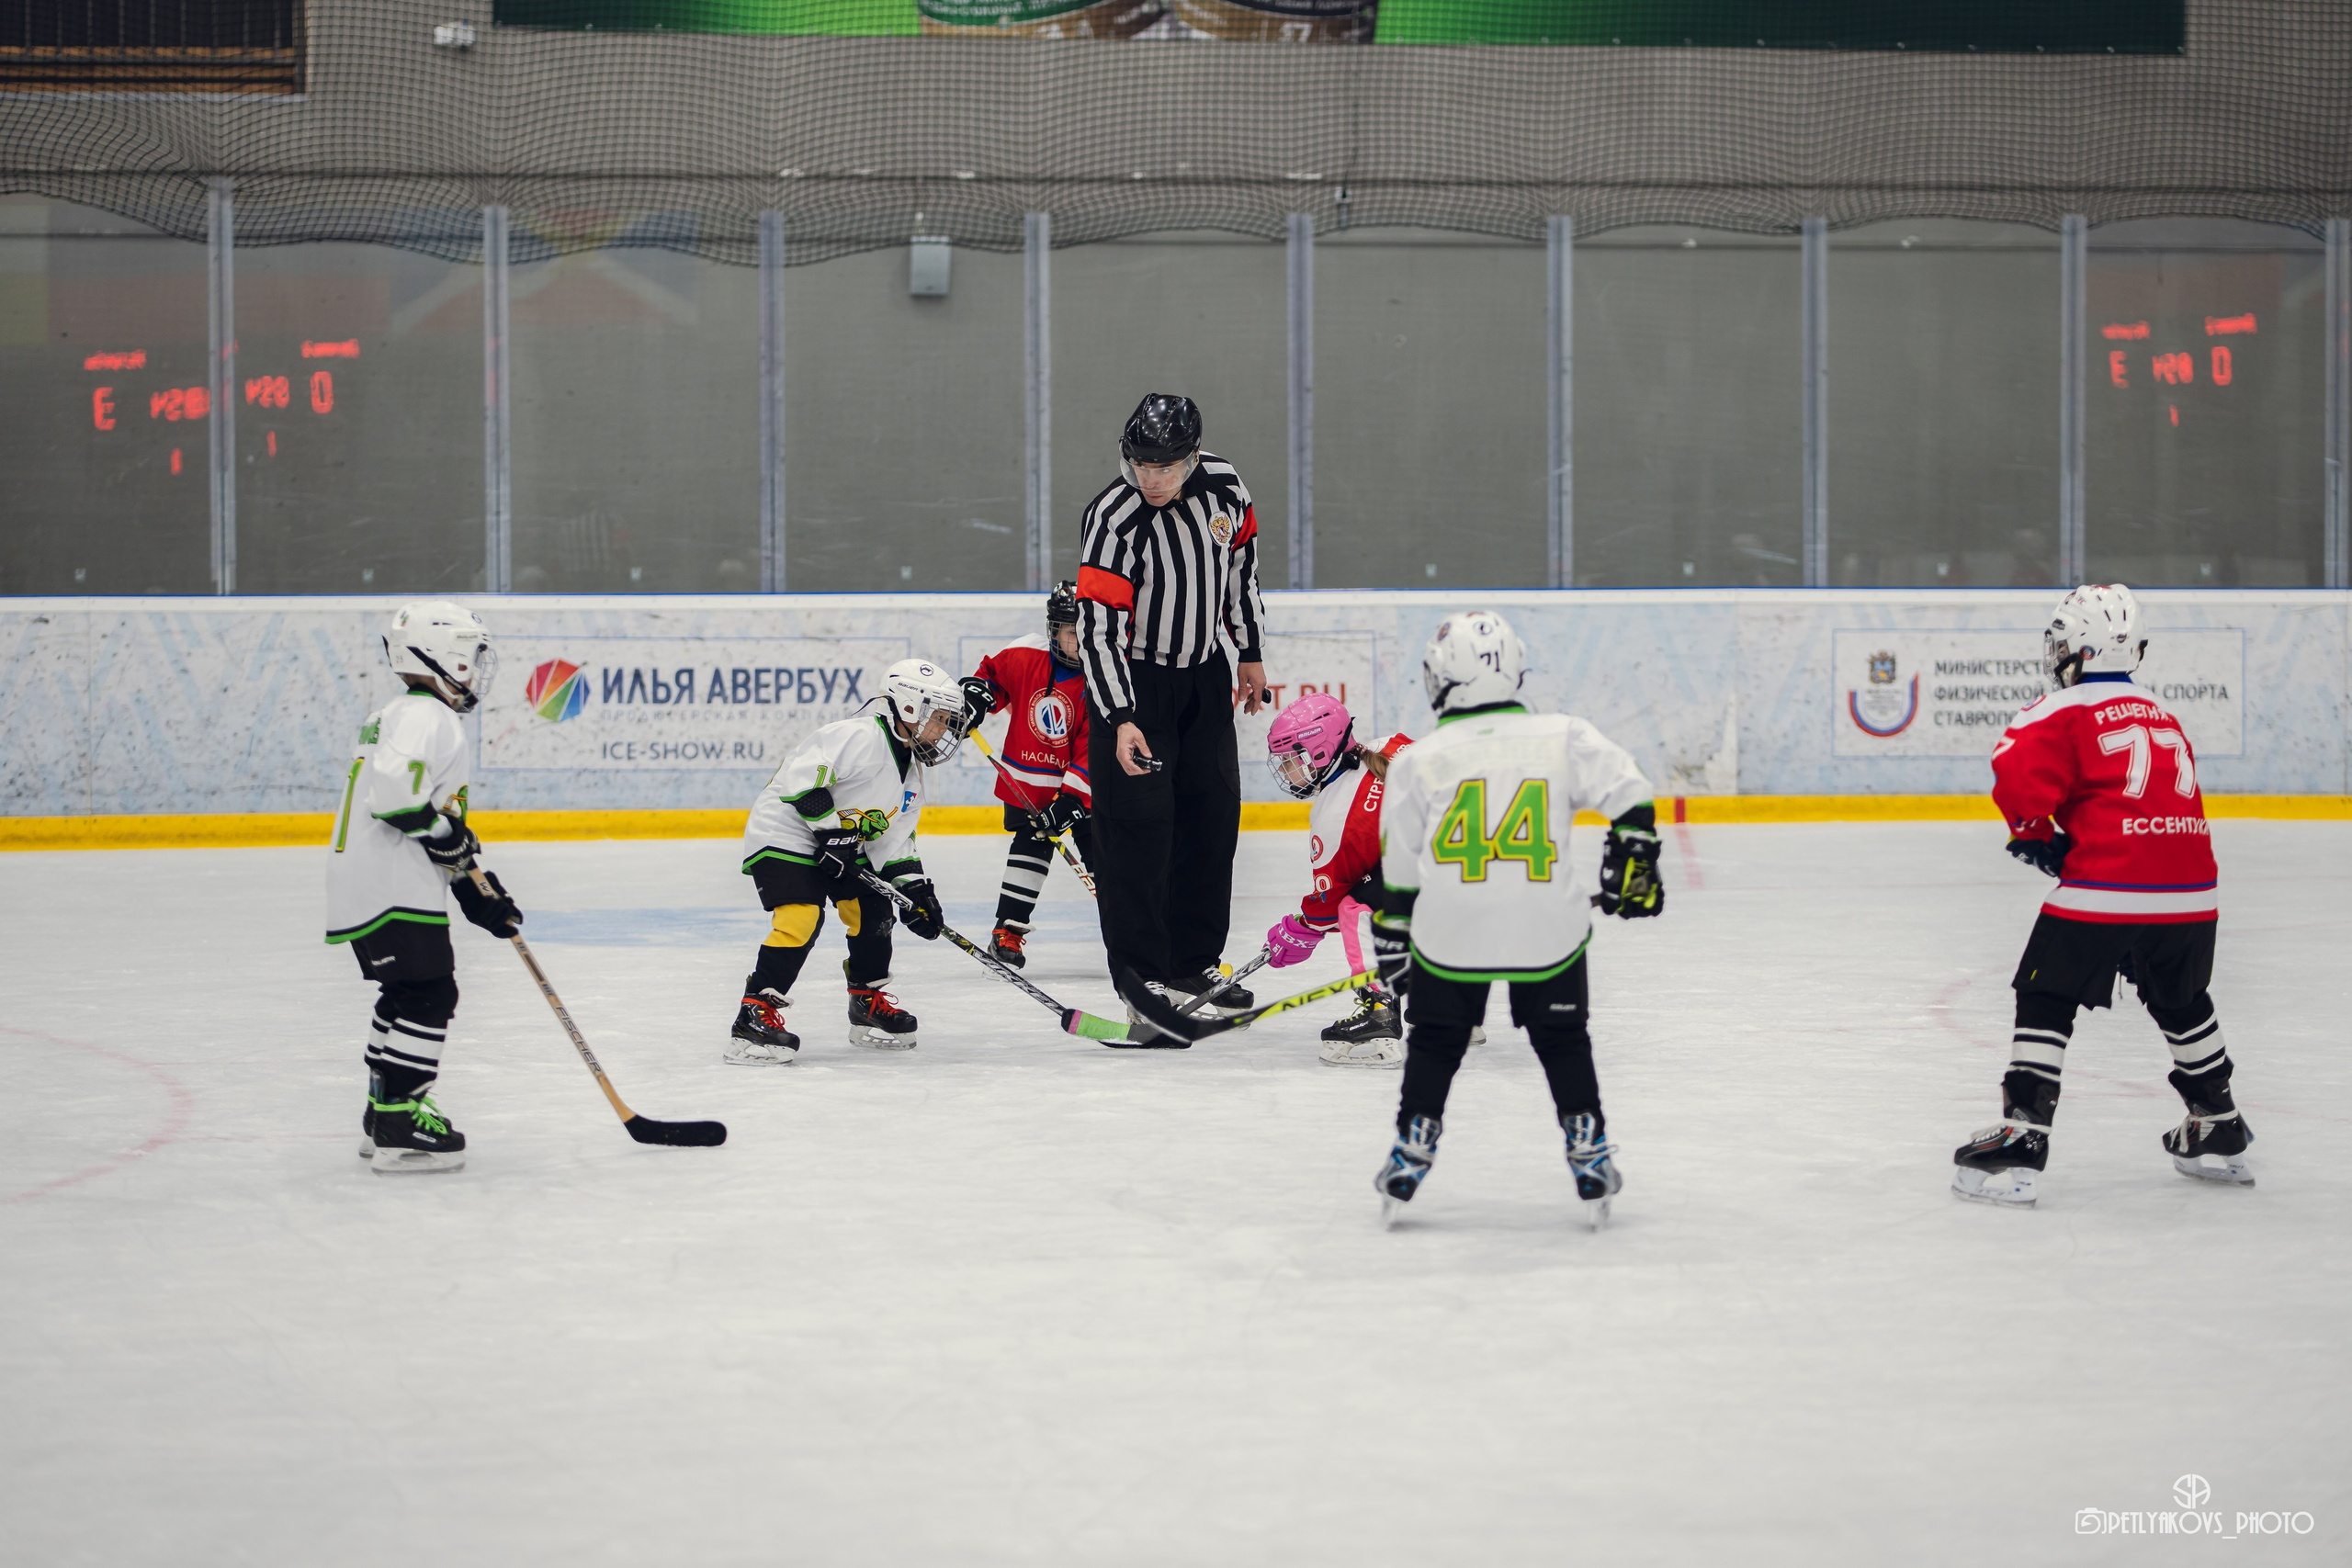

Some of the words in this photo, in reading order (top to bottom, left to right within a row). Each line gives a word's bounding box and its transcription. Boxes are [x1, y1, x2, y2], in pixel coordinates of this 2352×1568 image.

[602, 668, 696, 705] ИЛЬЯ
[707, 668, 865, 705] АВЕРБУХ
[1934, 681, 2044, 701] ФИЗИЧЕСКОЙ
[2163, 682, 2230, 700] СПОРТА
[602, 742, 763, 761] ICE-SHOW.RU
[2098, 723, 2195, 800] 77
[409, 761, 425, 795] 7
[1432, 779, 1557, 883] 44
[555, 1006, 602, 1073] FISCHER
